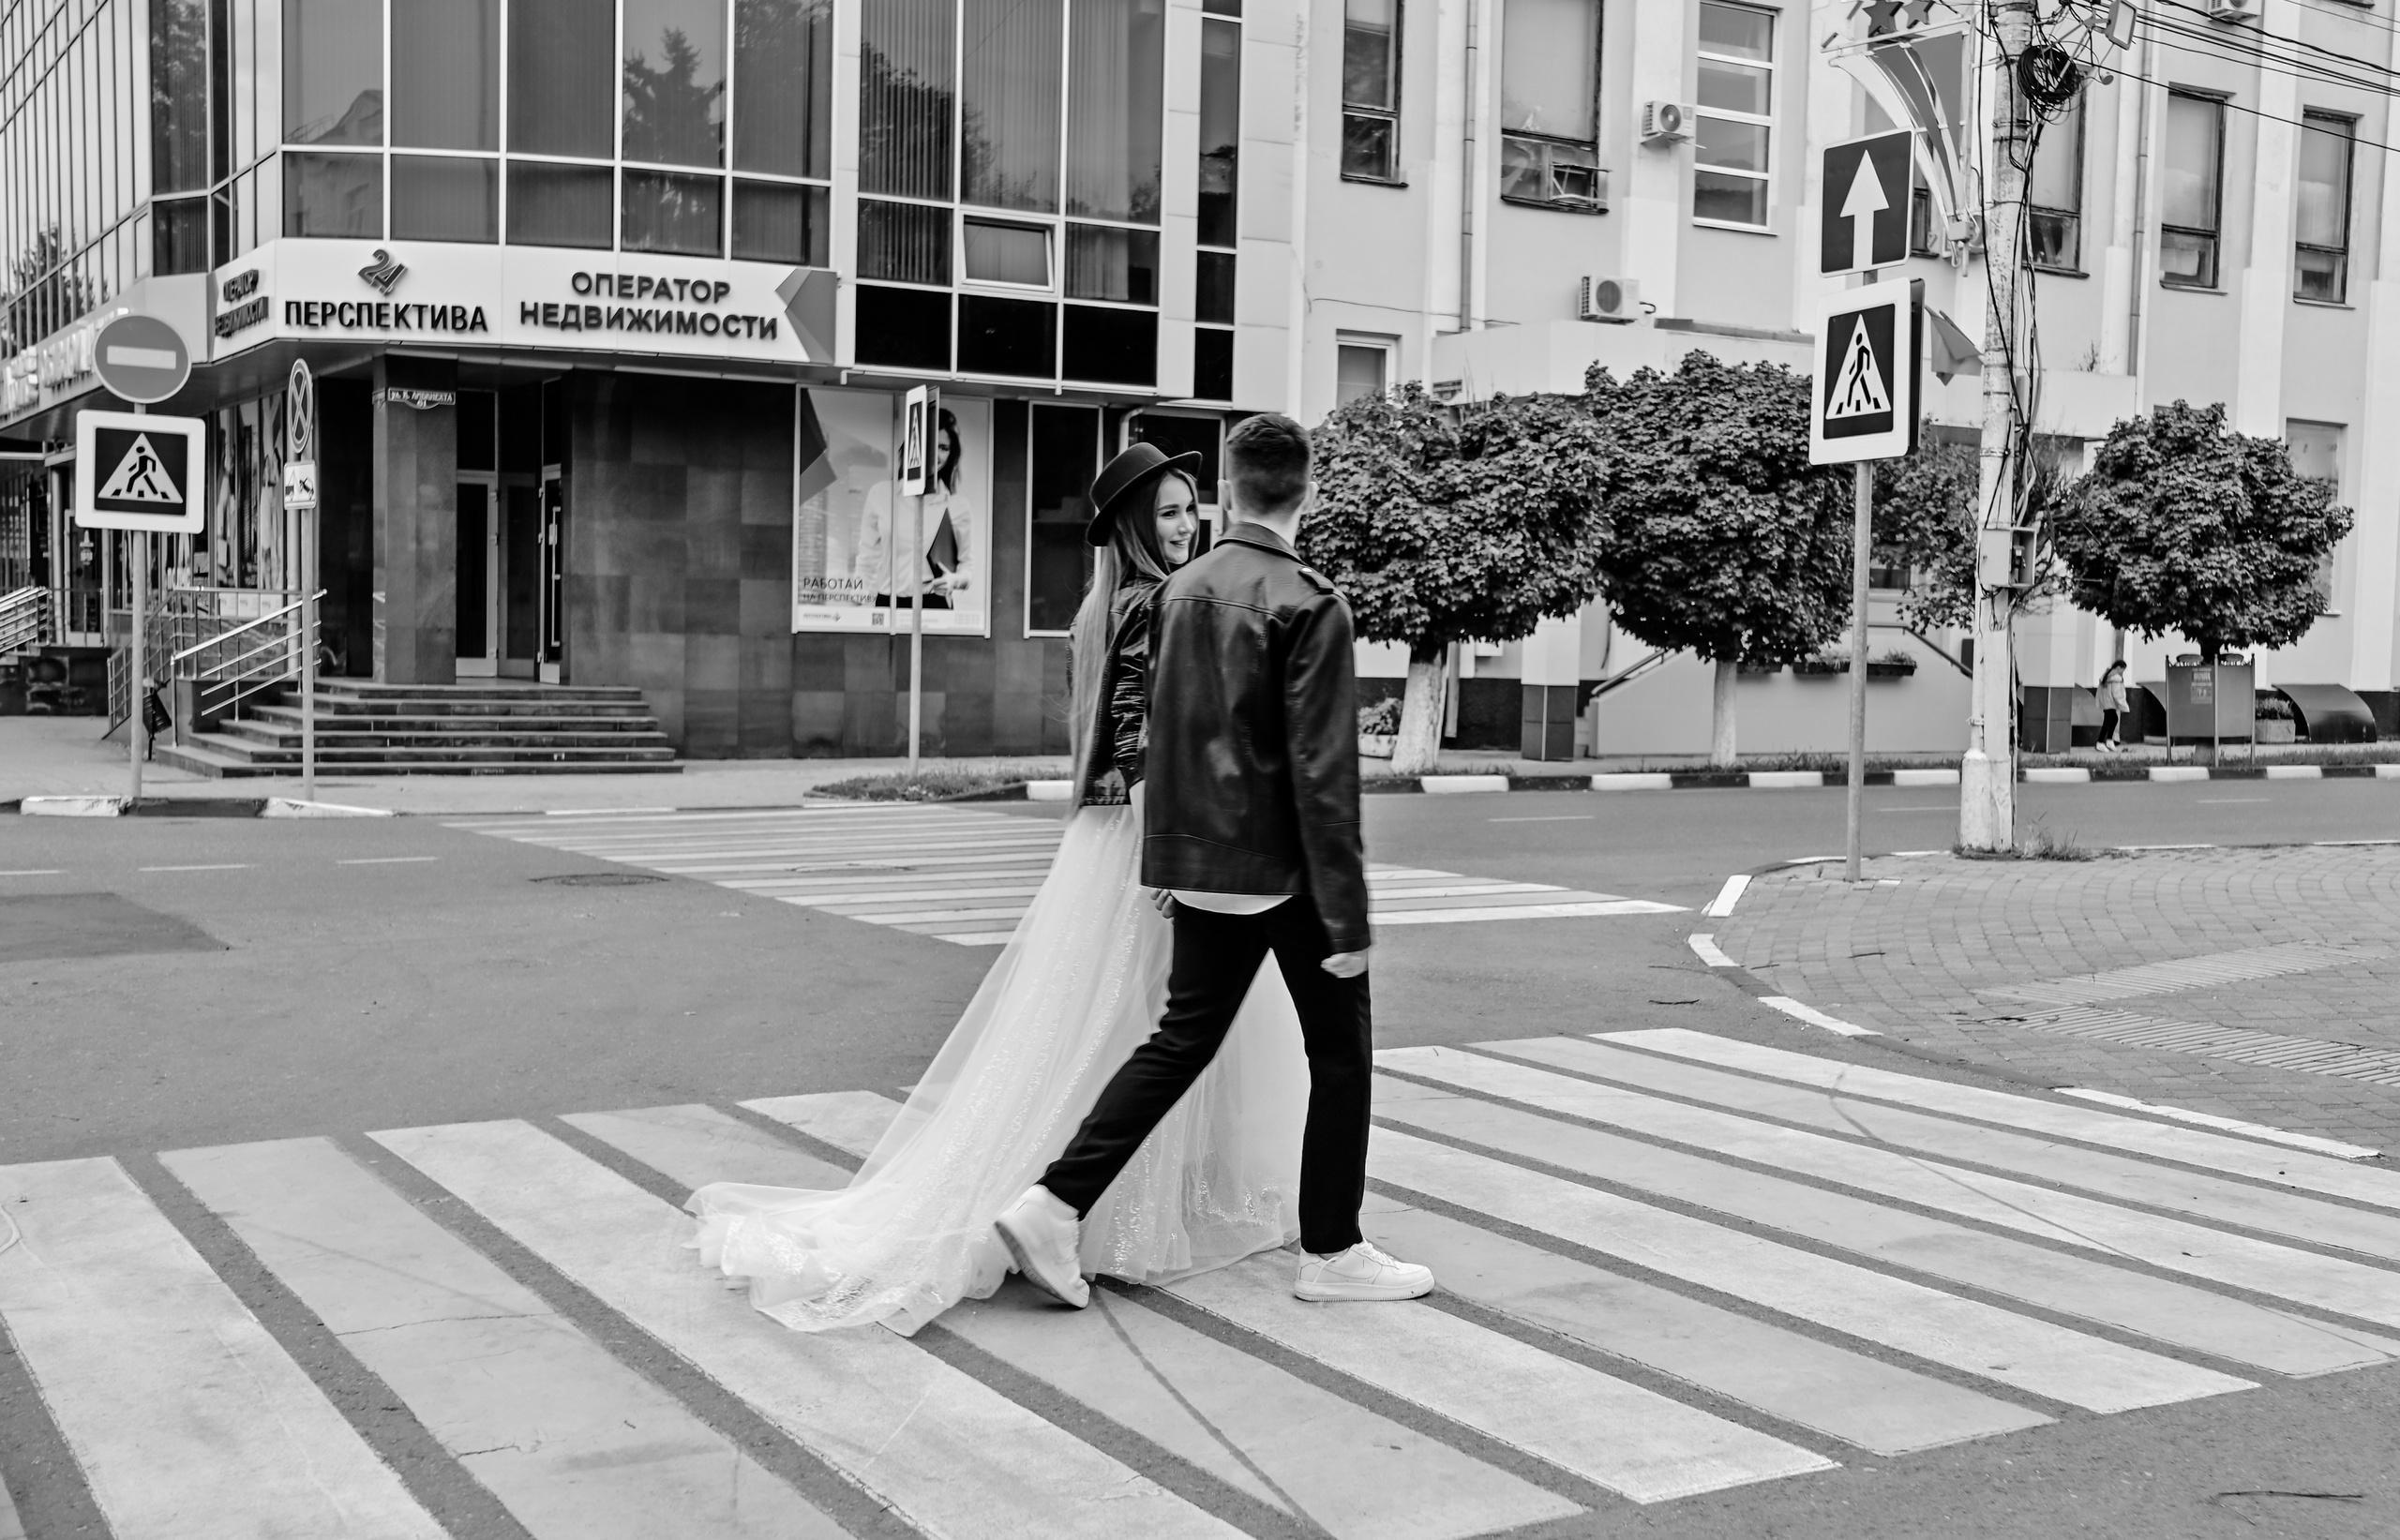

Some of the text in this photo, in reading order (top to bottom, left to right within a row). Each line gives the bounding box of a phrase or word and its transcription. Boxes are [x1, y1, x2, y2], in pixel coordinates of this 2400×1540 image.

[571, 272, 731, 305] ОПЕРАТОР
[284, 300, 489, 334] ПЕРСПЕКТИВА
[519, 301, 778, 341] НЕДВИЖИМОСТИ
[803, 576, 863, 591] РАБОТАЙ
